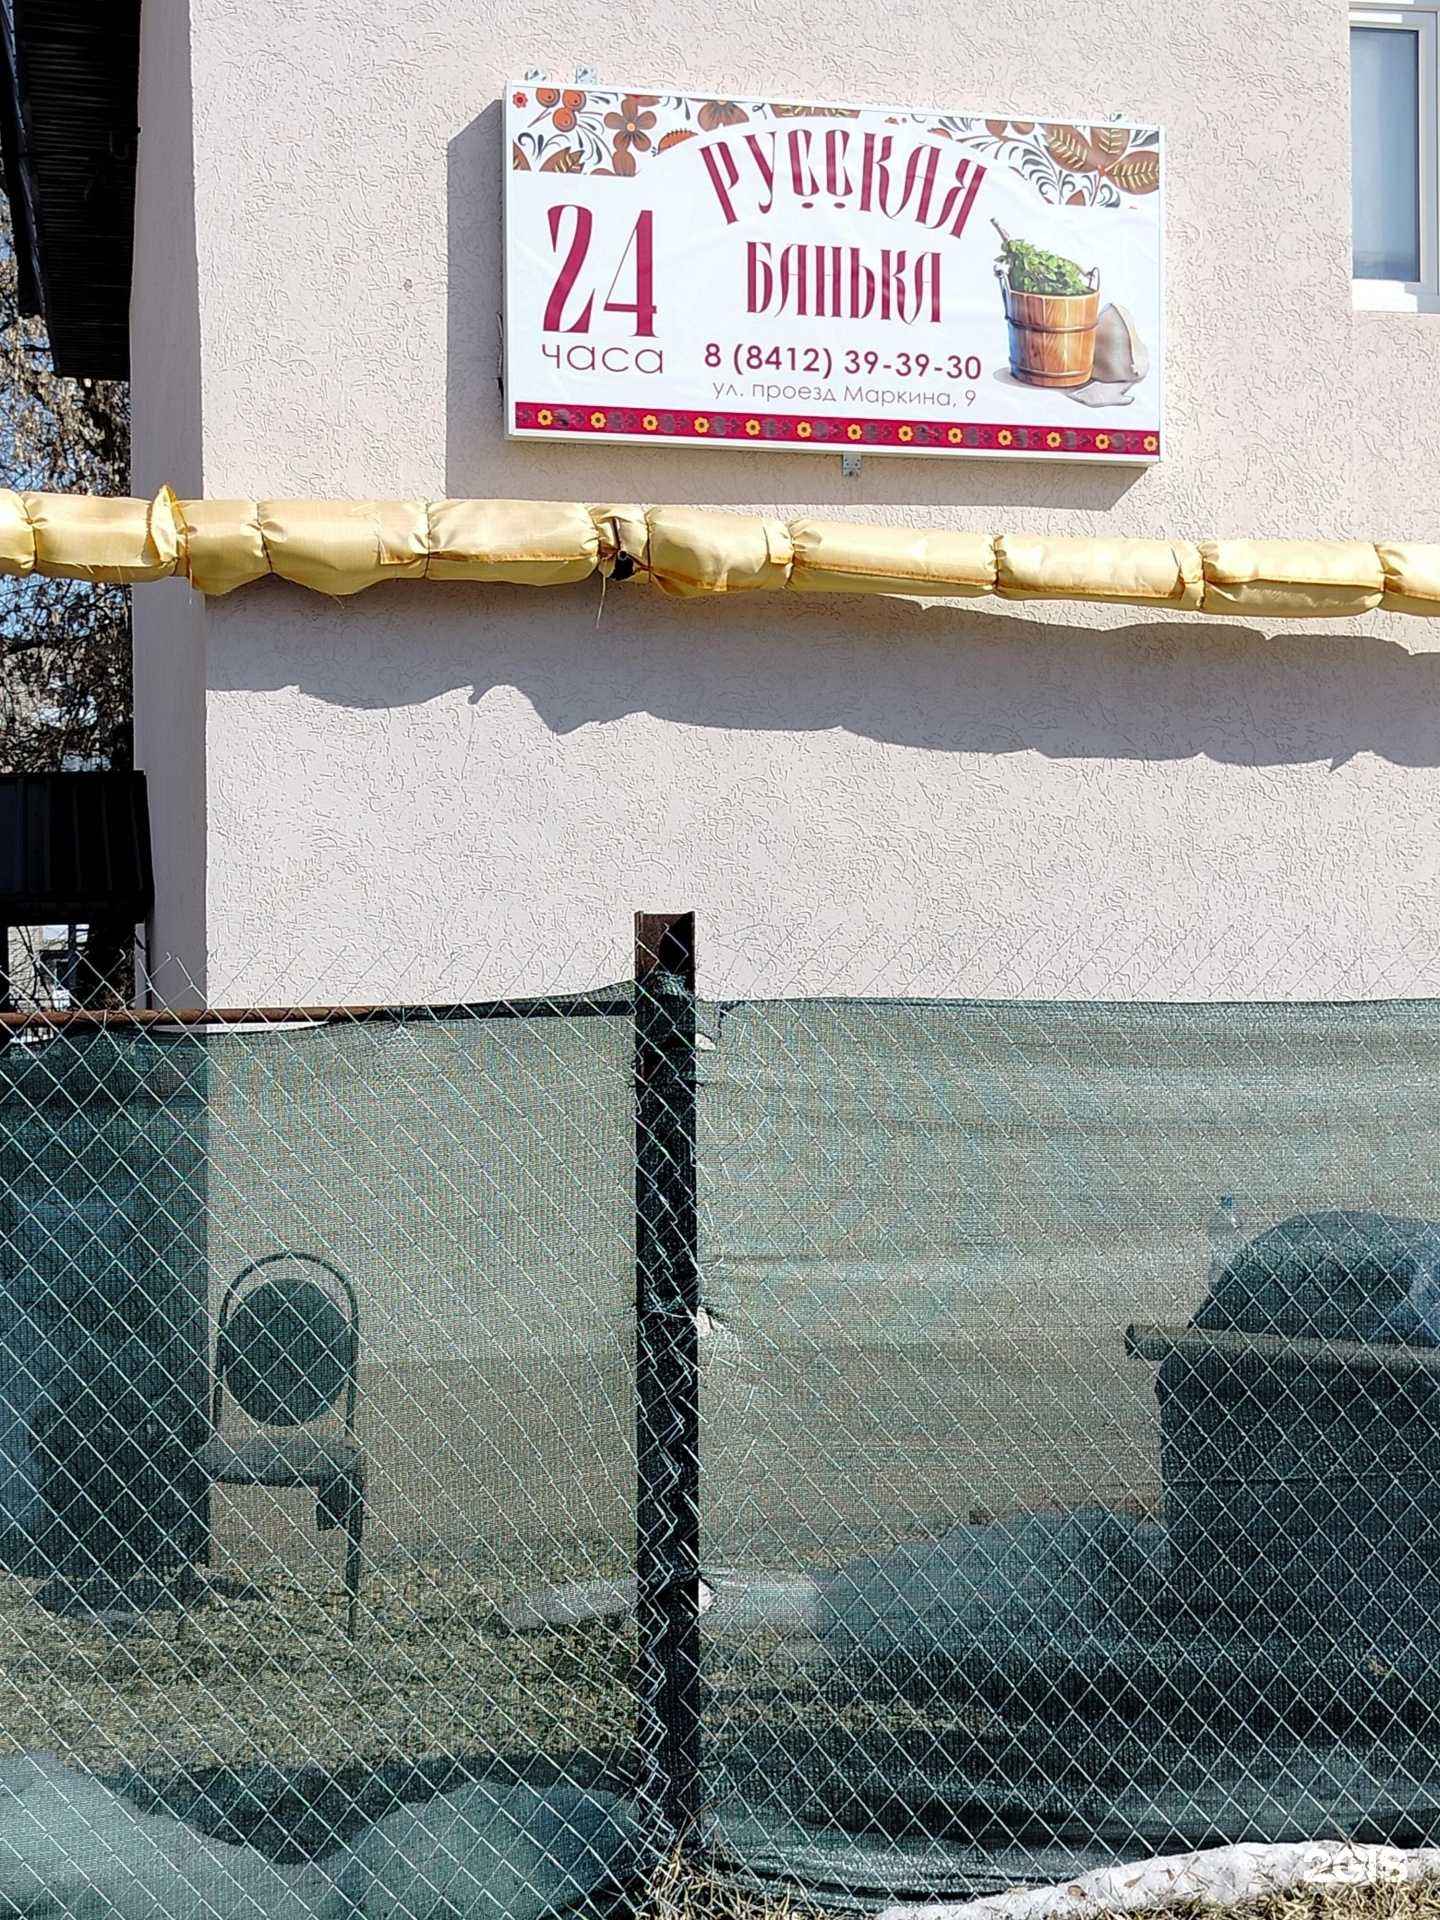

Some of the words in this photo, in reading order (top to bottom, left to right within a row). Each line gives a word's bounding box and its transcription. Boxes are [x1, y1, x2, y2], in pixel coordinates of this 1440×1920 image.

[698, 129, 988, 240] РУССКАЯ
[542, 204, 659, 338] 24
[746, 240, 942, 325] БАНЬКА
[541, 343, 664, 375] часа
[704, 343, 722, 368] 8
[733, 343, 833, 380] (8412)
[844, 350, 982, 380] 39-39-30
[712, 382, 744, 400] ул.
[752, 383, 837, 402] проезд
[844, 386, 957, 408] Маркина,
[964, 389, 977, 407] 9
